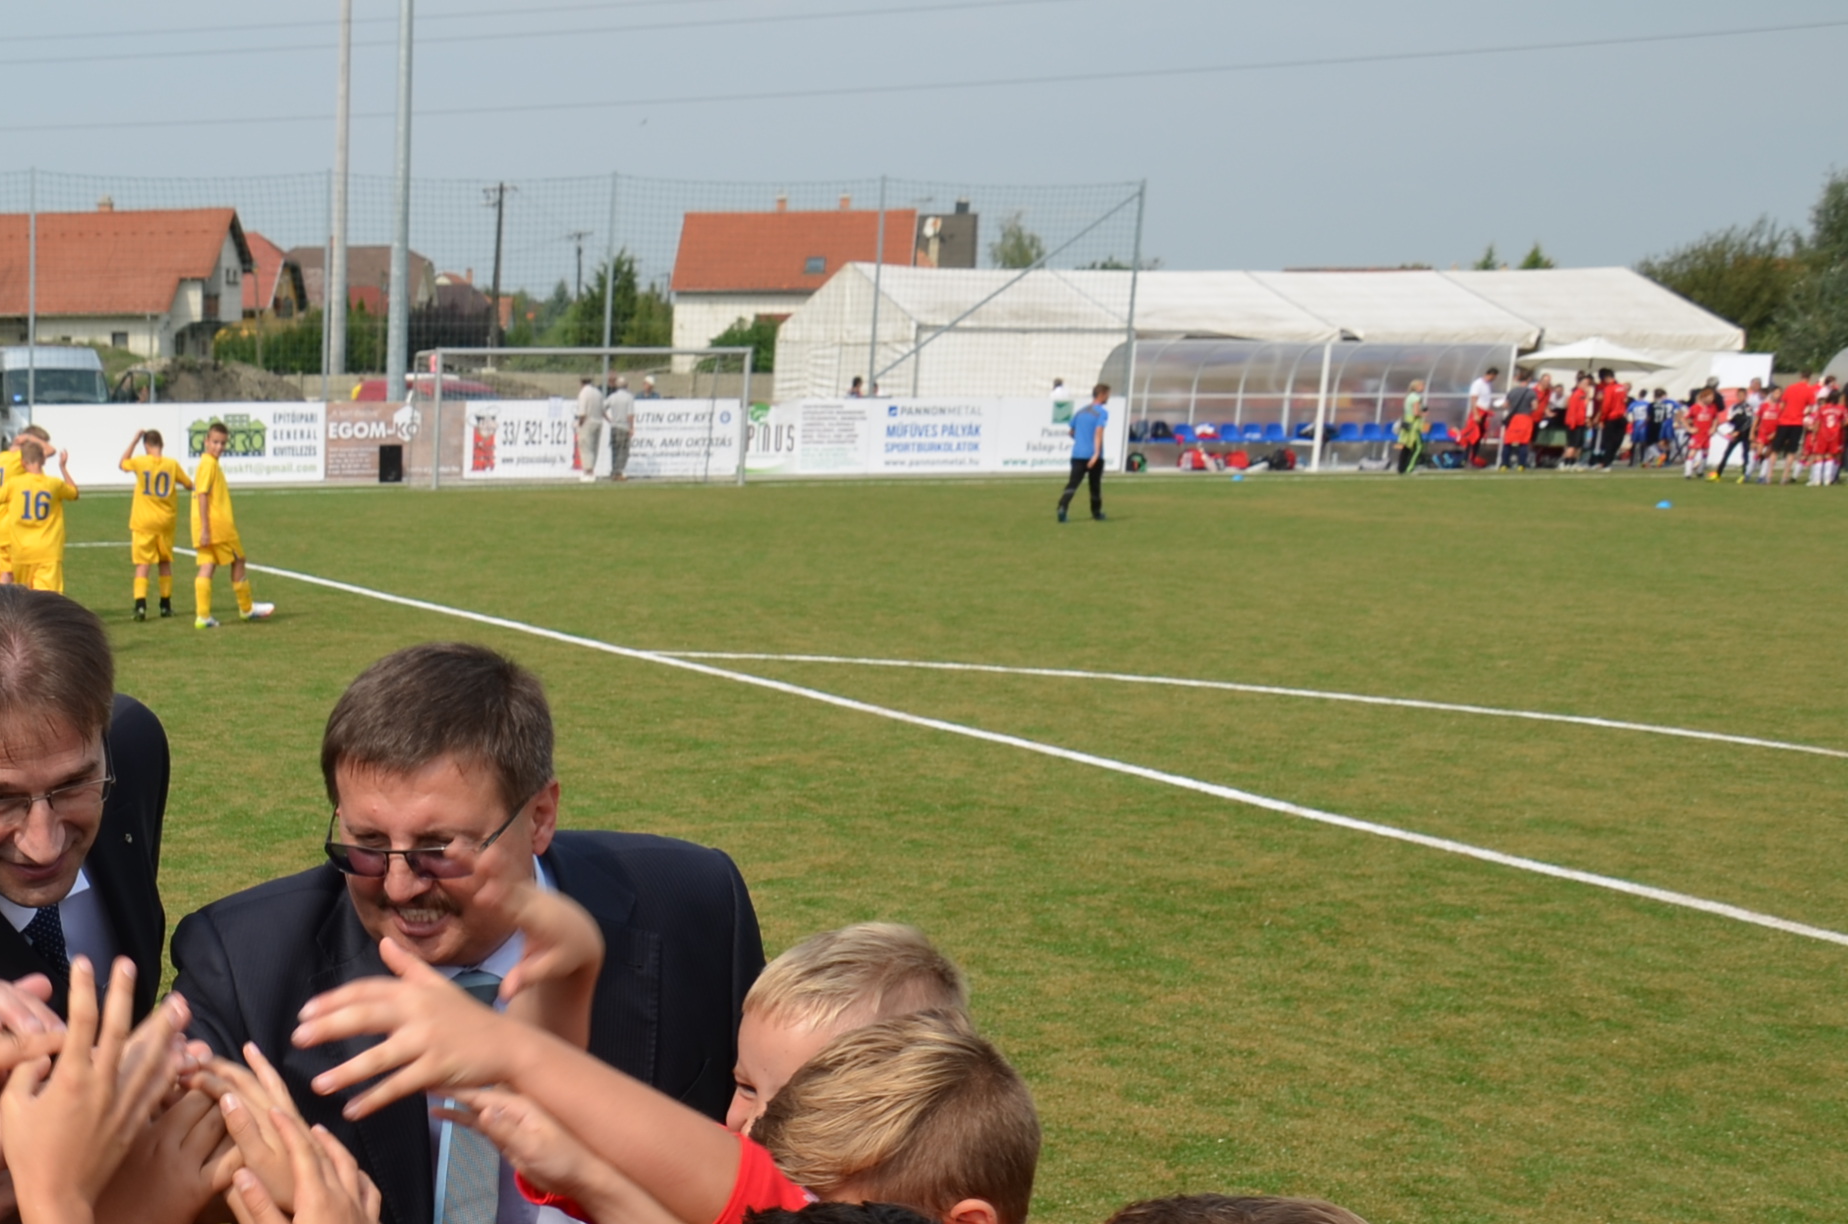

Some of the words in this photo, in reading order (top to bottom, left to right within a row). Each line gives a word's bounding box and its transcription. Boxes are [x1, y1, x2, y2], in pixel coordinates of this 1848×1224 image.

[633, 412, 664, 424] UTIN
[900, 405, 983, 416] PANNONMETAL
[143, 470, 170, 498] 10
[21, 490, 52, 521] 16
